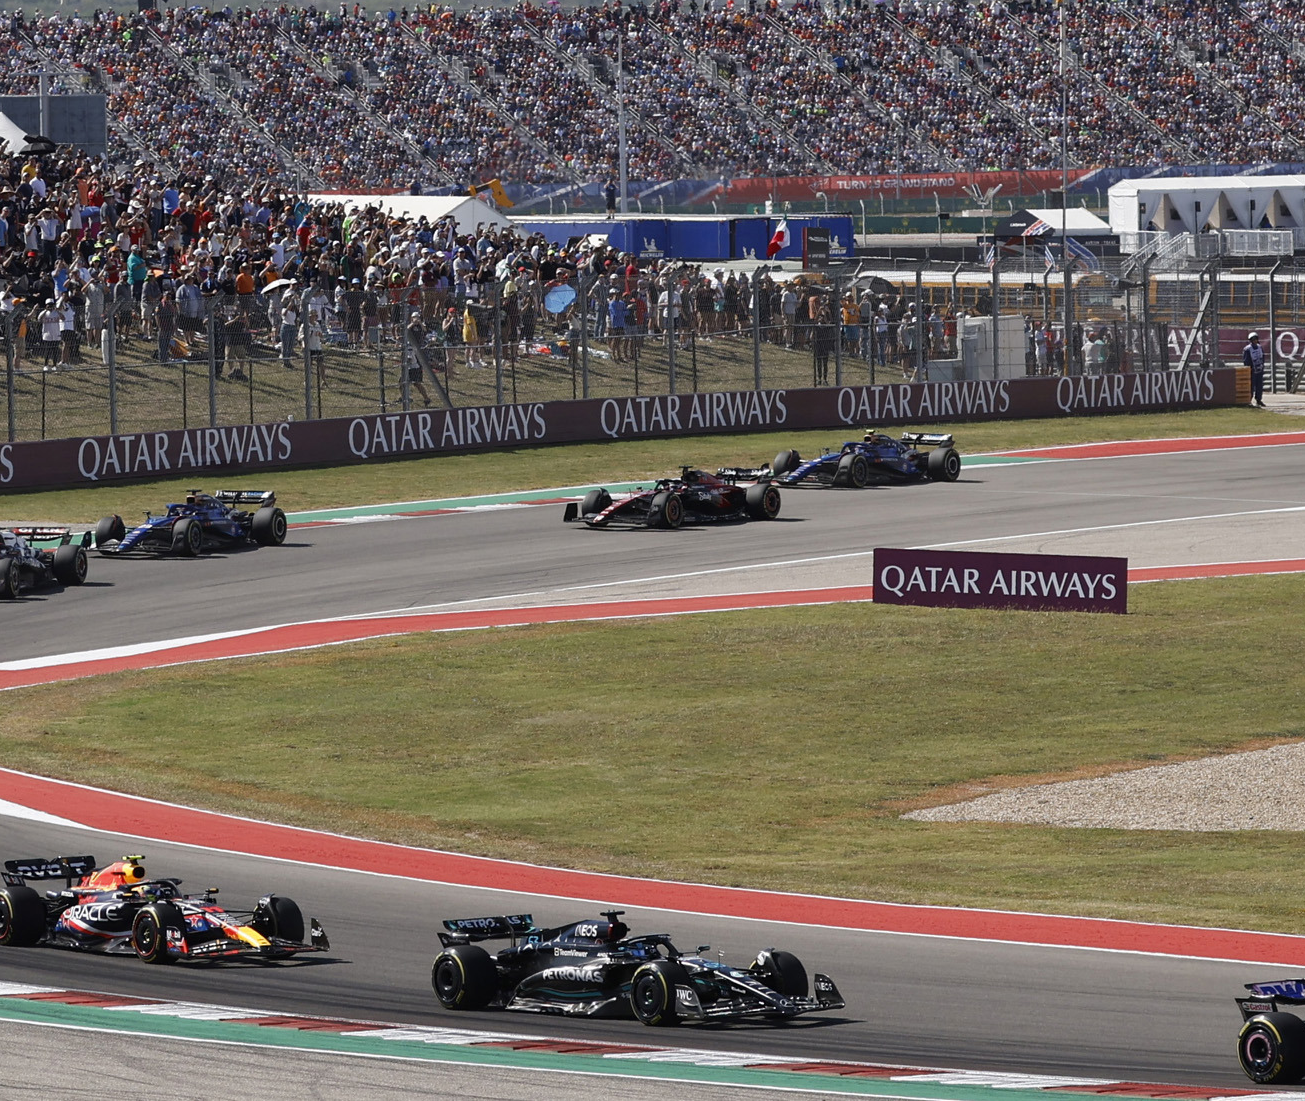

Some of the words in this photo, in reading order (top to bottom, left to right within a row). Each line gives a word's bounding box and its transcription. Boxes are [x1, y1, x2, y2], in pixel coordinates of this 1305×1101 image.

[837, 179, 867, 190] TURN
[882, 176, 956, 189] GRANDSTAND
[1056, 374, 1125, 413] QATAR
[1130, 369, 1215, 406] AIRWAYS
[837, 384, 913, 425] QATAR
[918, 380, 1010, 417] AIRWAYS
[600, 395, 683, 438] QATAR
[688, 389, 788, 429] AIRWAYS
[348, 412, 435, 459] QATAR
[440, 403, 546, 447] AIRWAYS
[77, 432, 171, 481] QATAR
[177, 422, 292, 469] AIRWAYS
[880, 565, 981, 598] QATAR
[988, 569, 1118, 600] AIRWAYS
[62, 903, 125, 922] ORACLE
[457, 916, 521, 929] PETROS
[527, 935, 539, 944] 63
[559, 948, 589, 958] TeamViewer
[542, 968, 604, 983] PETRONAS
[676, 988, 693, 1001] IWC
[1249, 1003, 1272, 1012] Castrol
